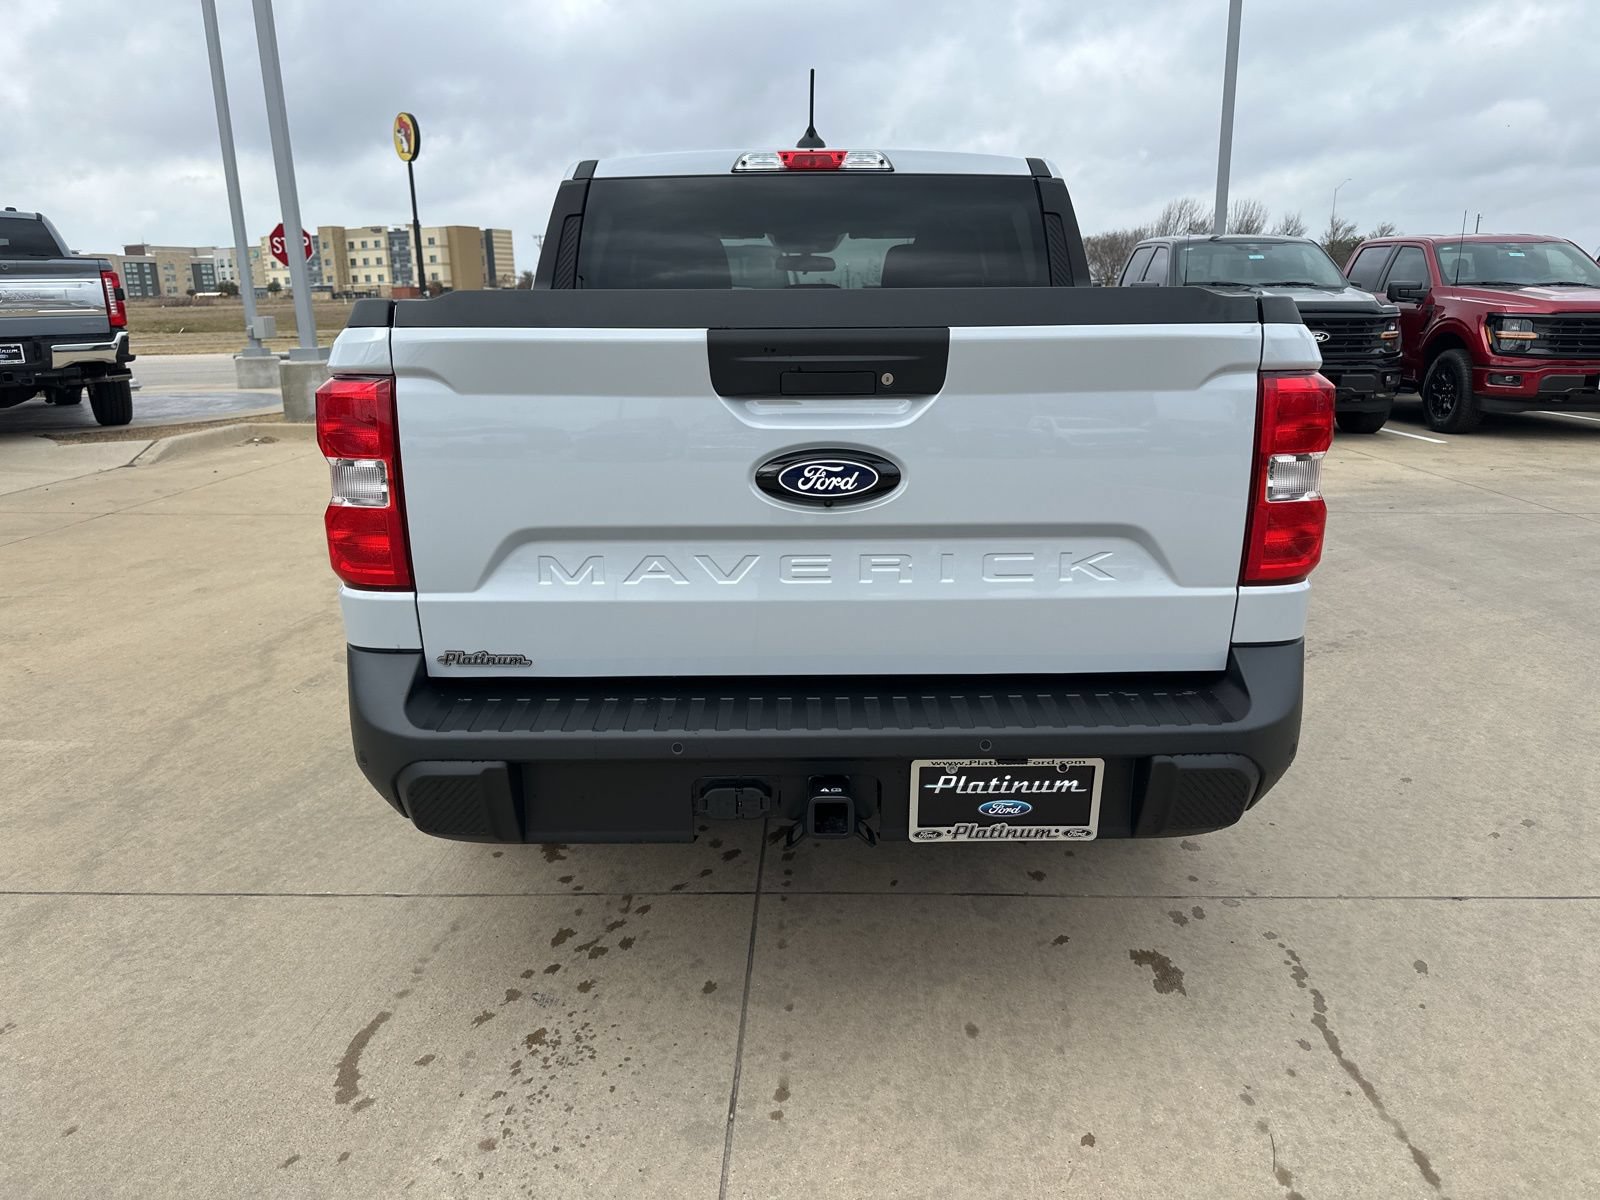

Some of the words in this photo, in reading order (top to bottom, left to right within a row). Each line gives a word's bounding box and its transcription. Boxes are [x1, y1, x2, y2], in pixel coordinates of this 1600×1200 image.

[272, 236, 309, 254] SP
[797, 465, 860, 491] Ford
[537, 551, 1117, 586] MAVERICK
[437, 650, 532, 667] Platinum
[923, 774, 1088, 794] Platinum
[988, 802, 1022, 815] Ford
[945, 824, 1059, 840] Platinum
